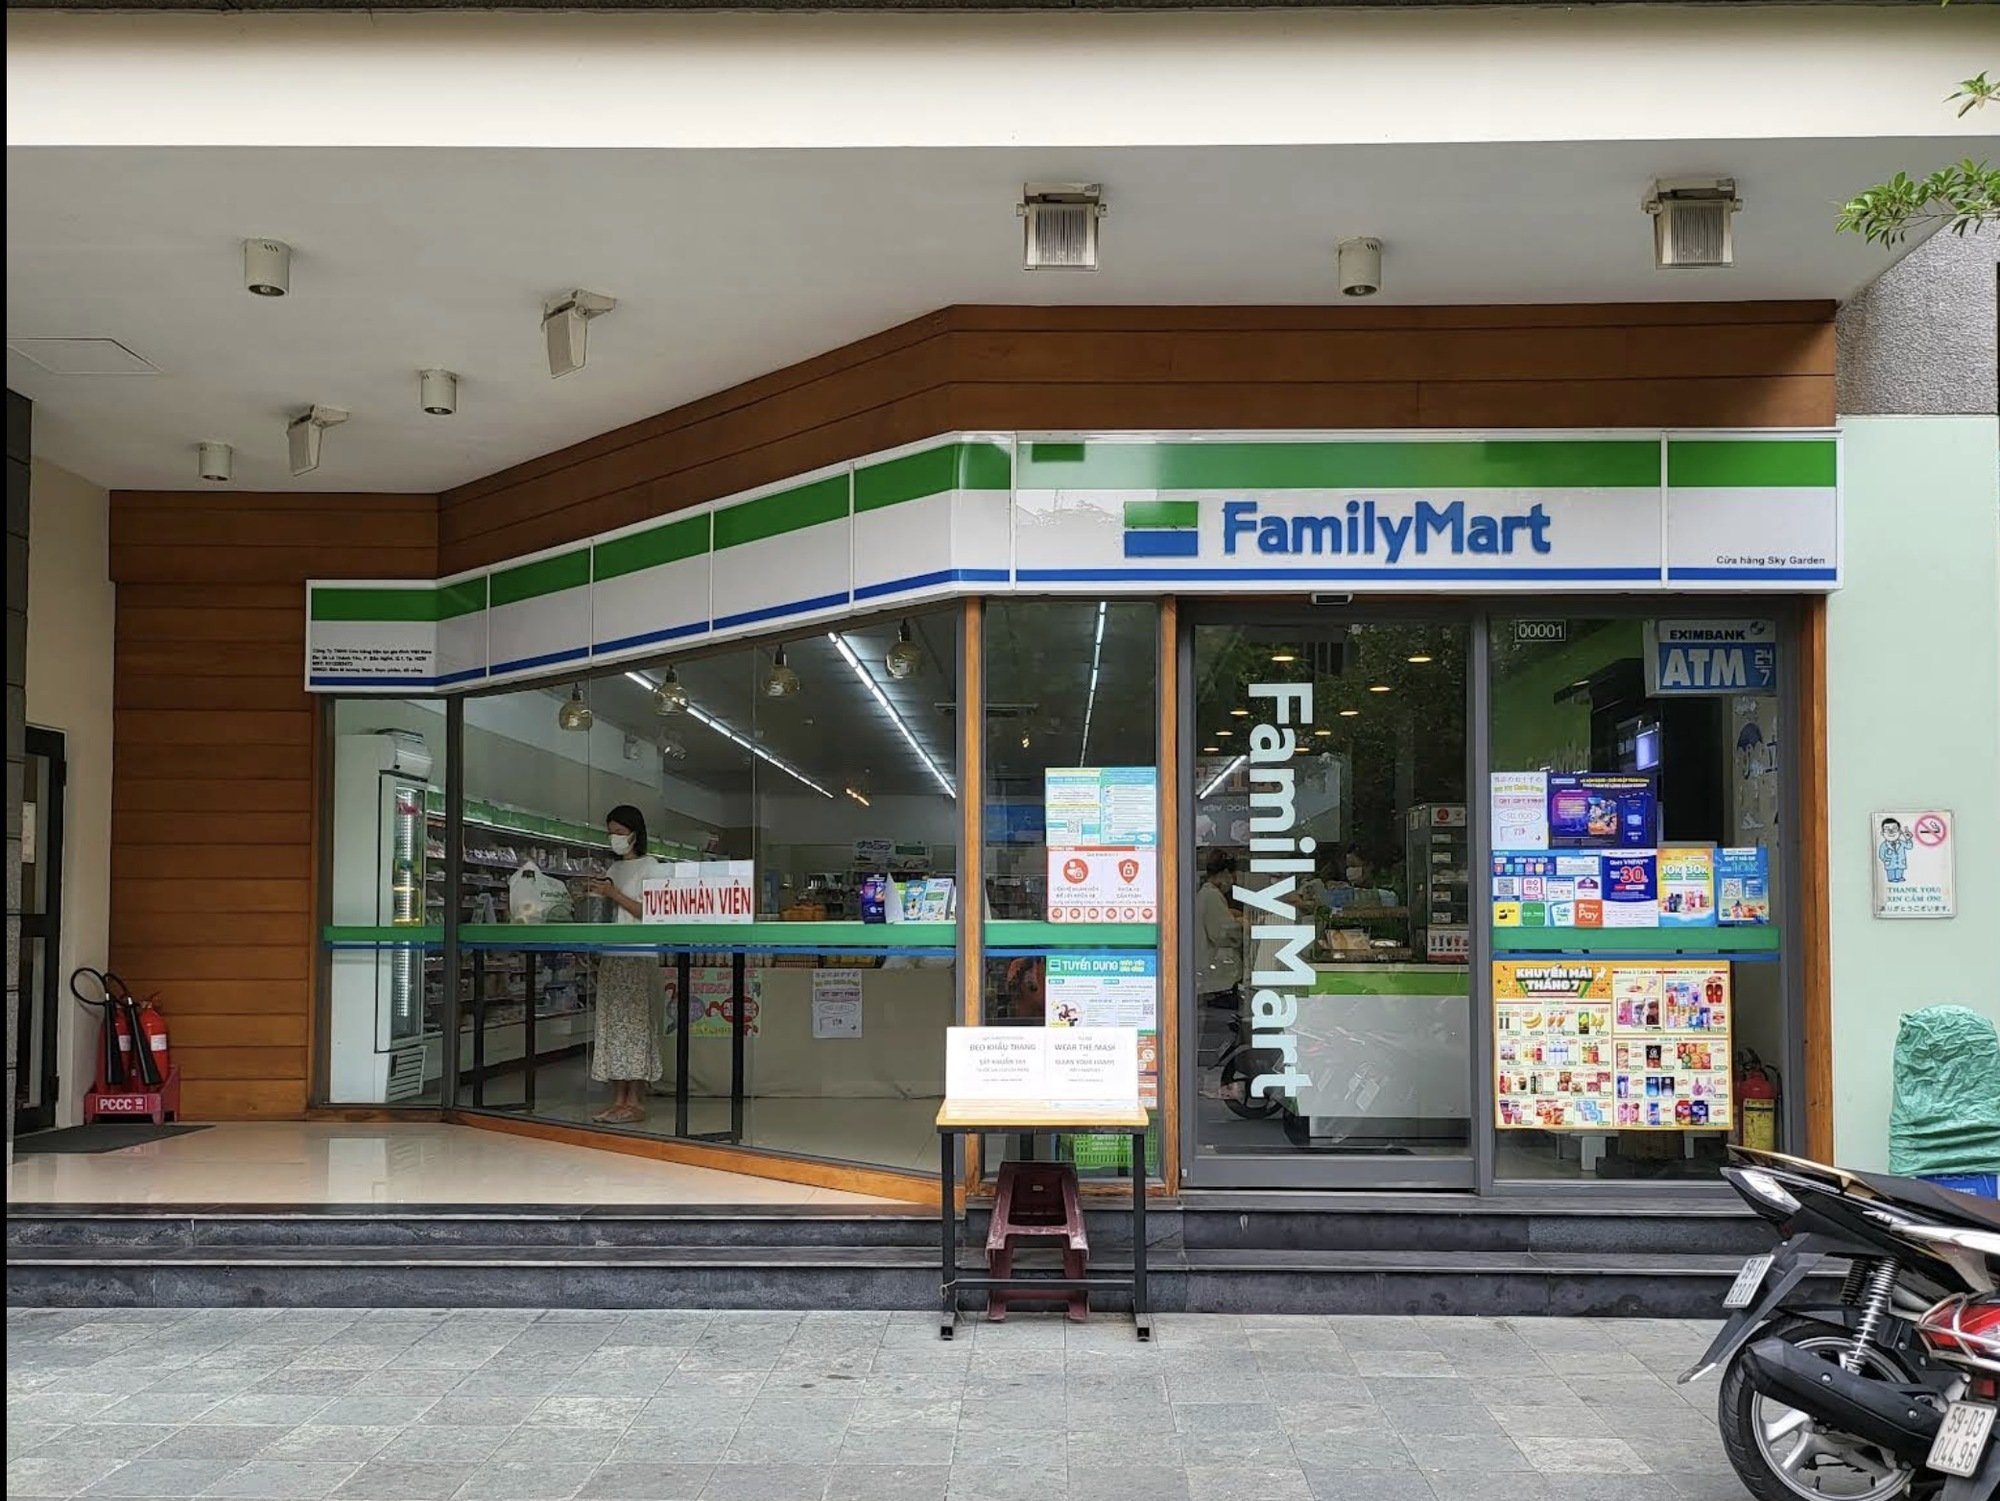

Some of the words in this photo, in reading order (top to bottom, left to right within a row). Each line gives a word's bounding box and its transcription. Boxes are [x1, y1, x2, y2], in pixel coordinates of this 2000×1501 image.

[1223, 500, 1551, 563] FamilyMart
[1716, 555, 1738, 565] Cửa
[1740, 554, 1765, 567] hàng
[1768, 555, 1786, 566] Sky
[1789, 555, 1826, 565] Garden
[1518, 624, 1563, 638] 00001
[1669, 628, 1745, 641] EXIMBANK
[1754, 649, 1773, 665] 24
[1662, 648, 1746, 687] ATM
[1761, 671, 1770, 685] 7
[643, 879, 678, 916] TUYỂN
[680, 879, 714, 915] NHÂN
[719, 879, 751, 915] VIÊN
[1232, 682, 1317, 1099] FamilyMart
[1578, 909, 1599, 920] Pay
[1527, 978, 1570, 991] THÁNG
[1570, 980, 1581, 990] 7
[1054, 1043, 1077, 1051] WEAR
[1079, 1043, 1092, 1051] THE
[100, 1098, 132, 1110] PCCC
[1947, 1406, 1986, 1438] 59-D3
